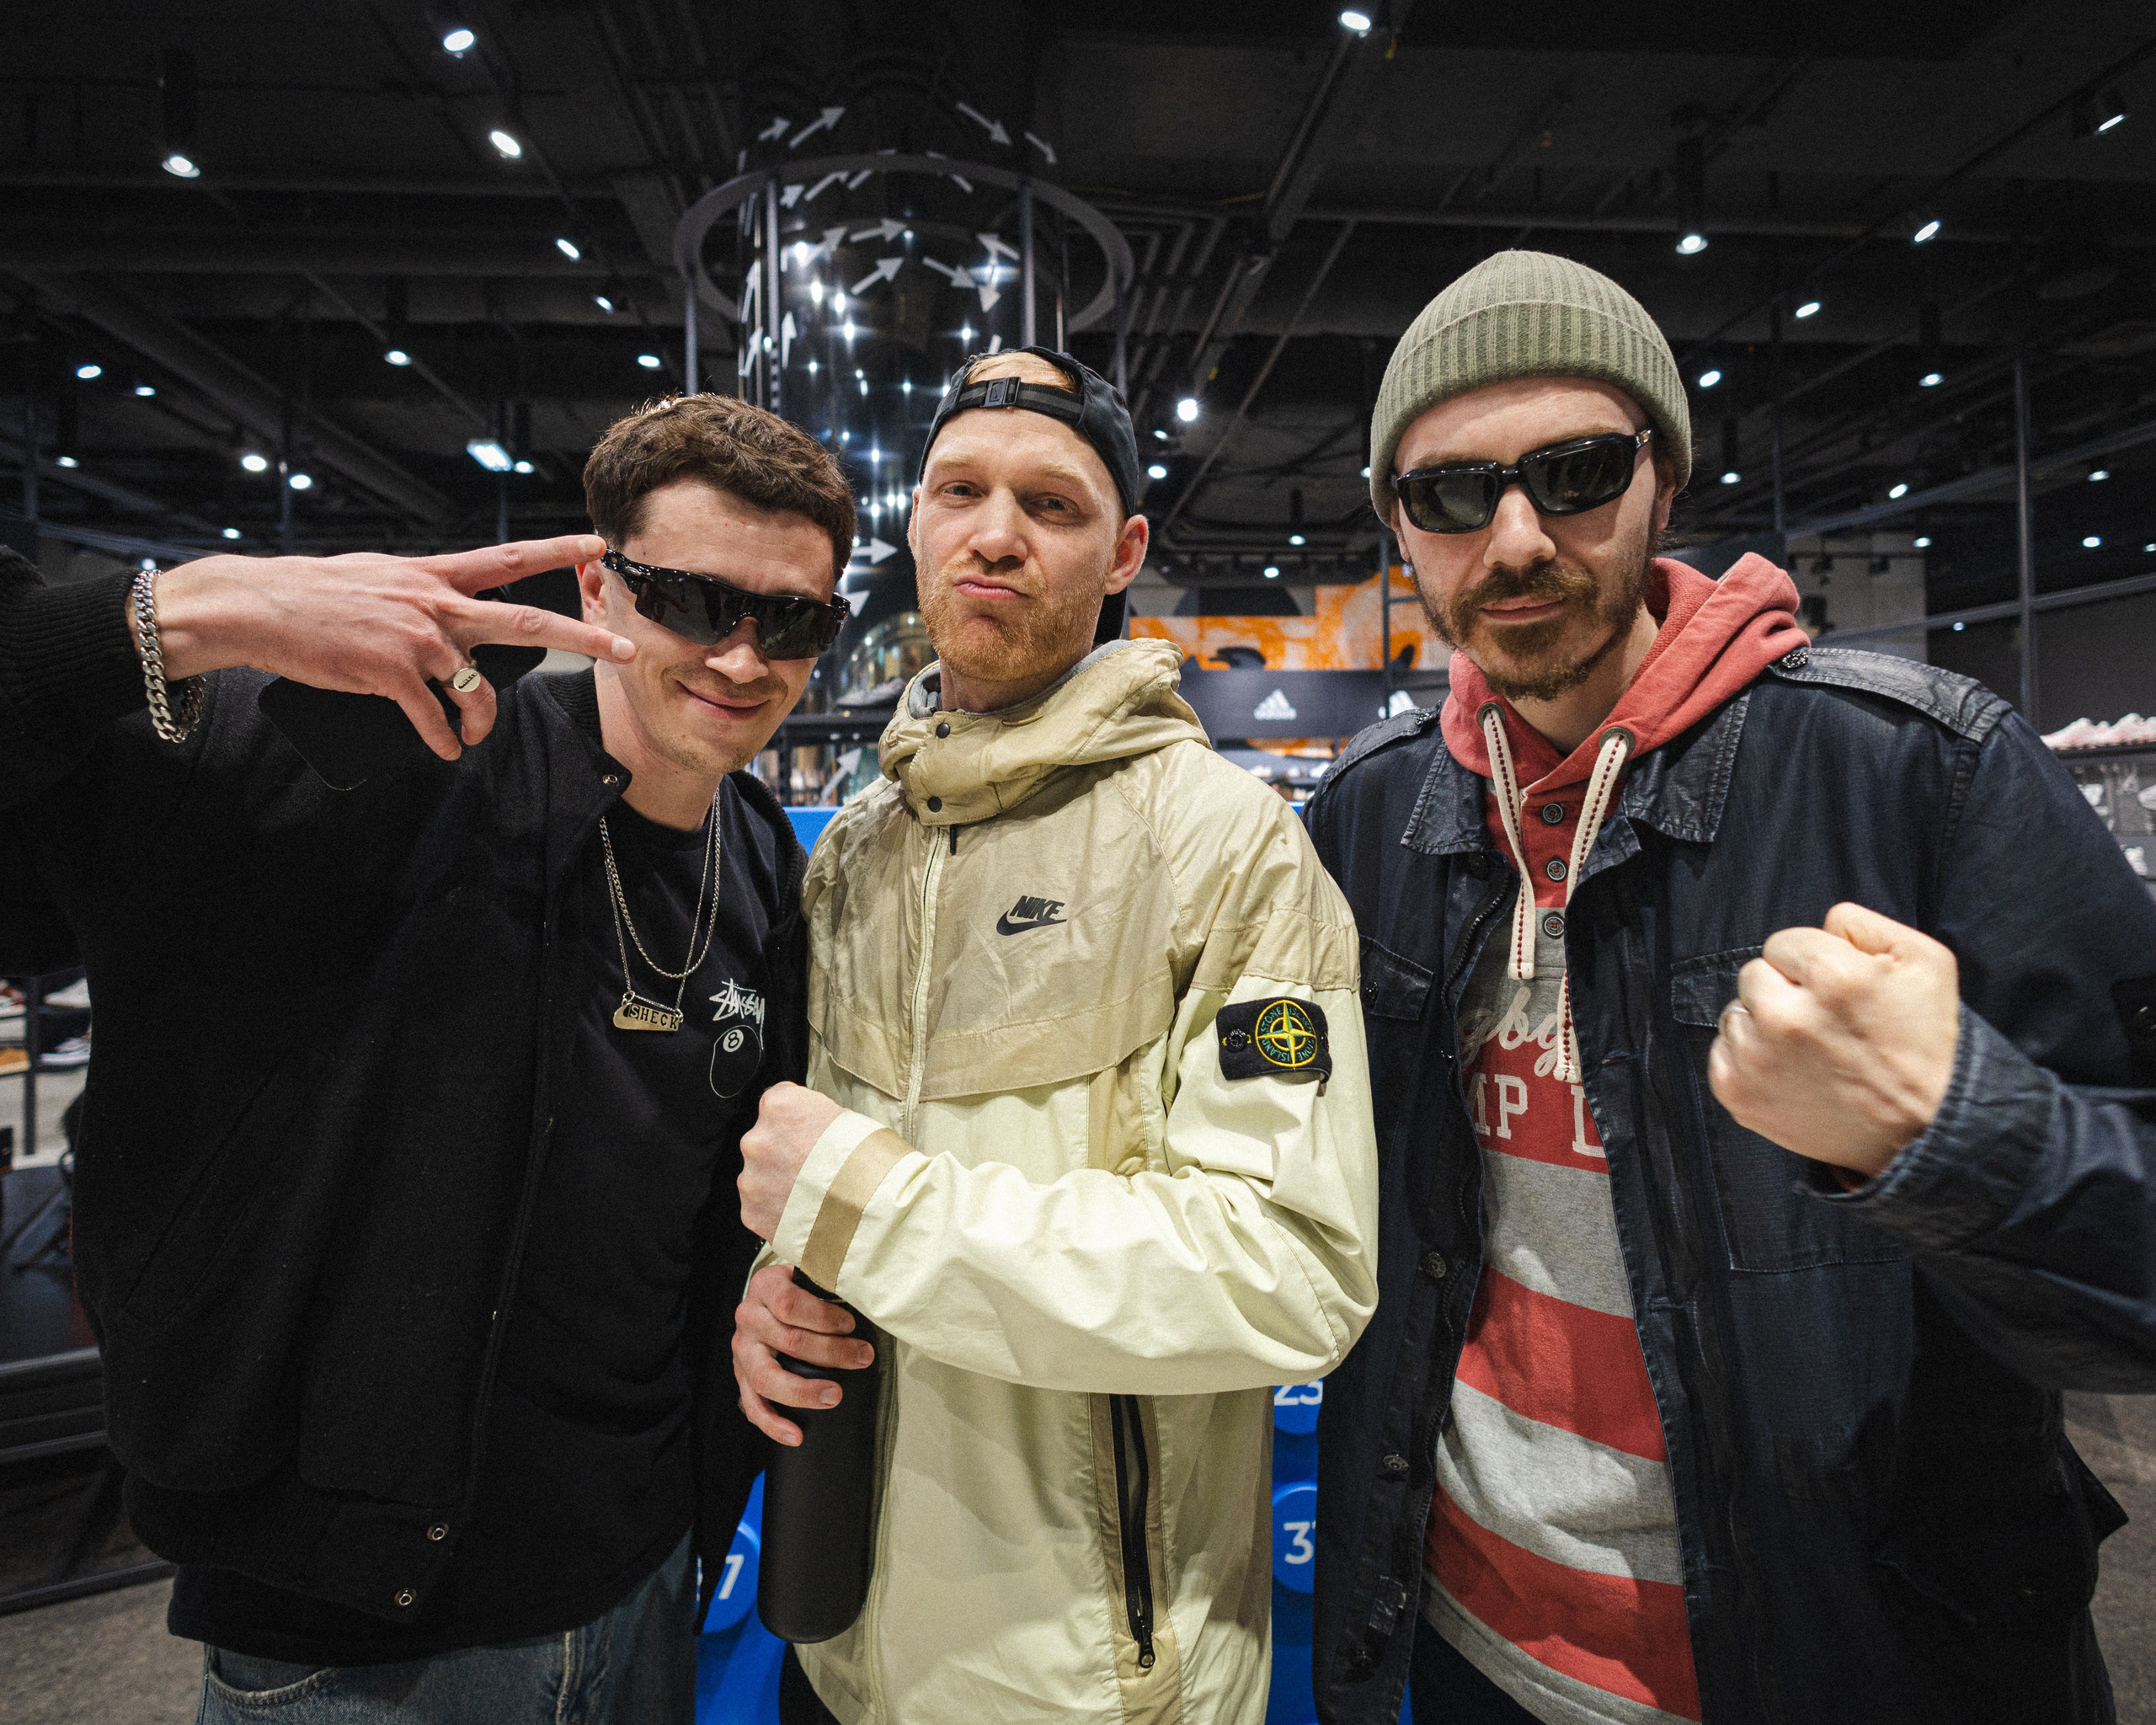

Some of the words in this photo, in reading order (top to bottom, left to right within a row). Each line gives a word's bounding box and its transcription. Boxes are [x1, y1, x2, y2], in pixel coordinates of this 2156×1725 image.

[1009, 895, 1065, 921] NIKE
[1261, 1007, 1283, 1033] STONE
[727, 1031, 740, 1049] 8
[1283, 1519, 1316, 1565] 3
